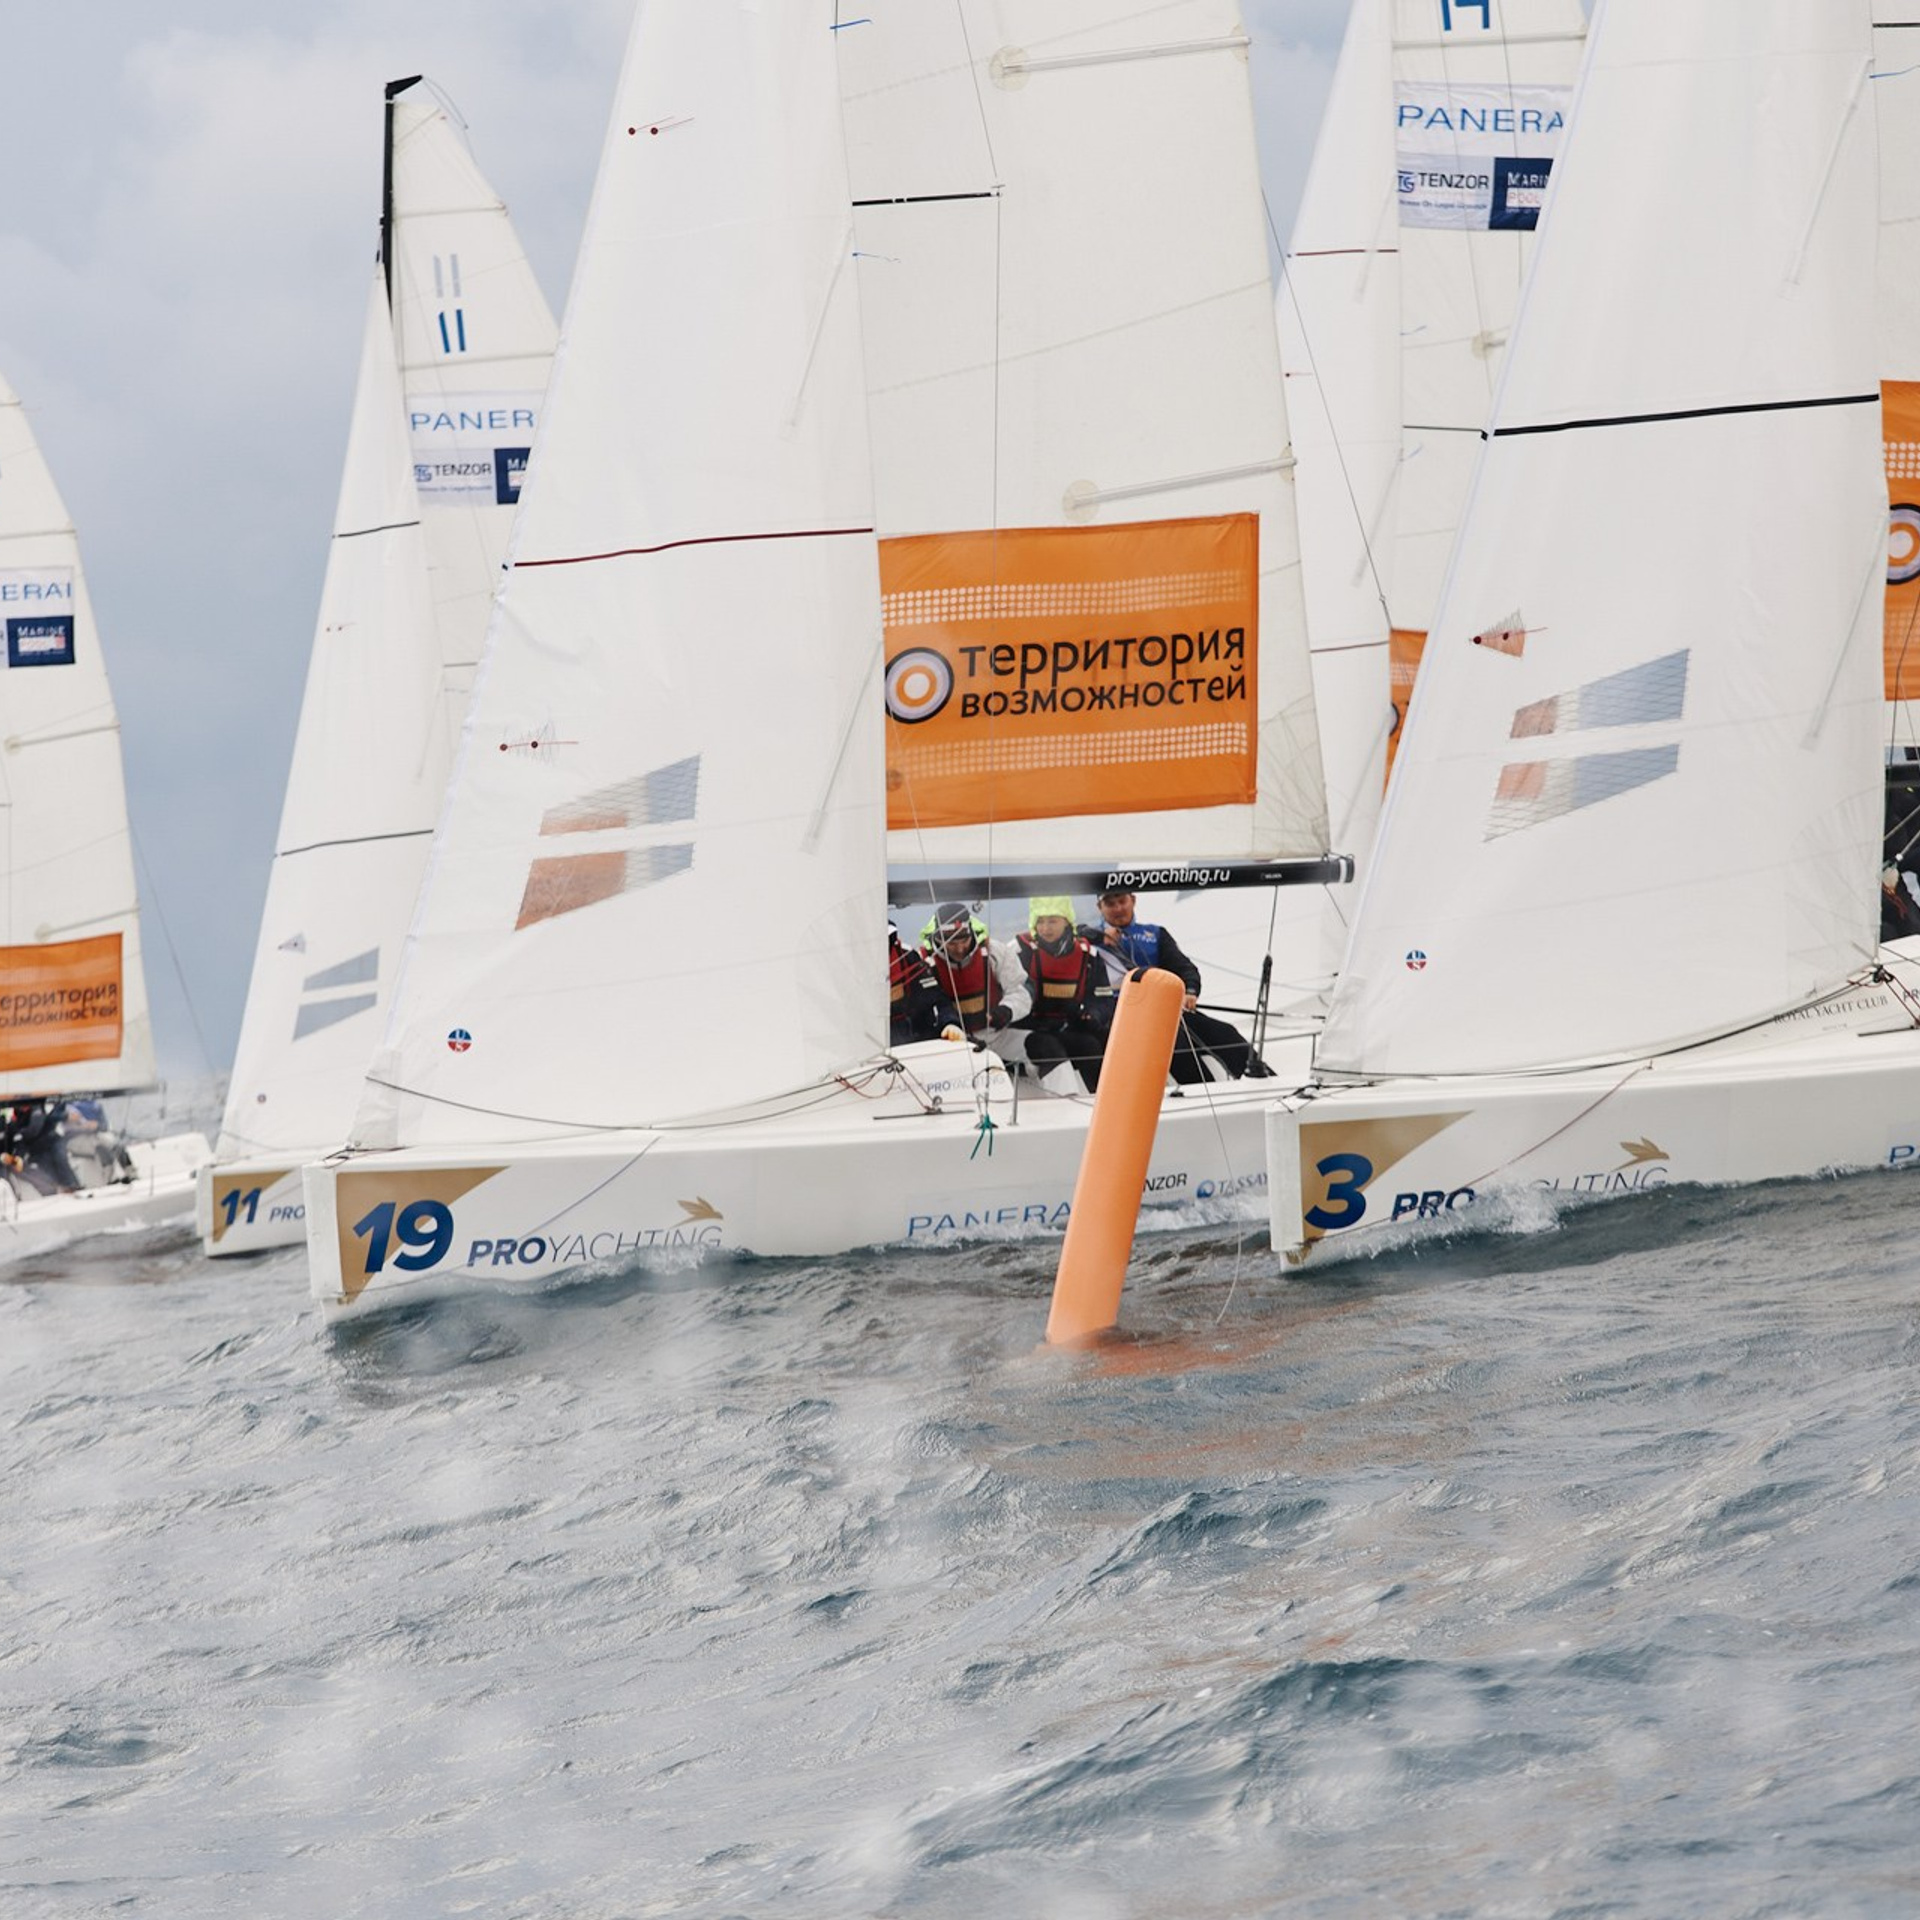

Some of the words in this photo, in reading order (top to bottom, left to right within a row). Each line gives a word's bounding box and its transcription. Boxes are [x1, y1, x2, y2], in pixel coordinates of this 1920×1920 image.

[1397, 105, 1564, 133] PANERA
[1418, 172, 1490, 190] TENZOR
[410, 409, 534, 432] PANER
[434, 463, 492, 477] TENZOR
[2, 582, 71, 601] ERAI
[959, 627, 1246, 689] территория
[960, 664, 1246, 718] возможностей
[1106, 868, 1231, 889] pro-yachting.ru
[0, 983, 118, 1026] ерритория
[0, 1002, 118, 1028] озможностей
[1812, 1000, 1853, 1016] YACHT
[1857, 995, 1889, 1010] CLUB
[1143, 1173, 1187, 1193] NZOR
[1304, 1153, 1373, 1230] 3
[221, 1187, 262, 1227] 11
[269, 1204, 305, 1222] PRO
[908, 1201, 1072, 1238] PANERA
[352, 1200, 454, 1274] 19
